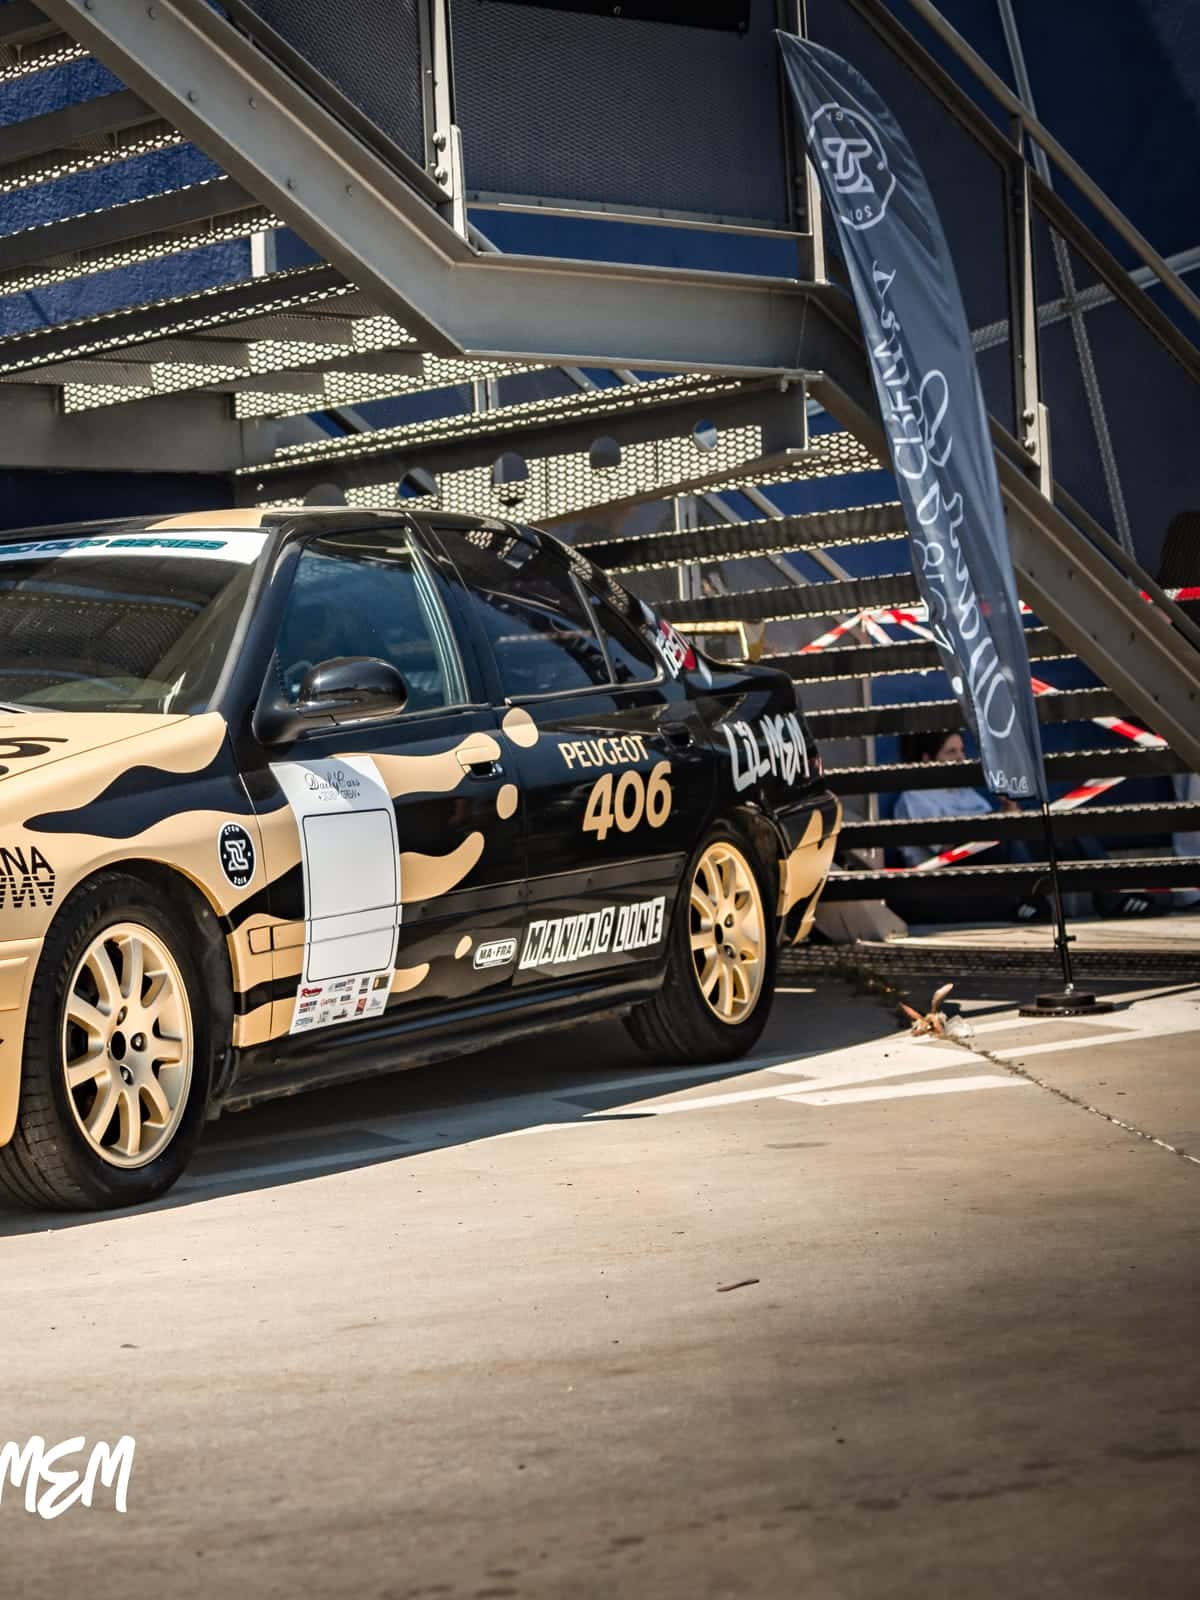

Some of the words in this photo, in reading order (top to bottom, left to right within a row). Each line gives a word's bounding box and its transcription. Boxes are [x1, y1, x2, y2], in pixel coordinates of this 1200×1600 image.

[557, 735, 649, 769] PEUGEOT
[582, 760, 672, 840] 406
[519, 906, 615, 969] MANIAC
[613, 896, 666, 953] LINE
